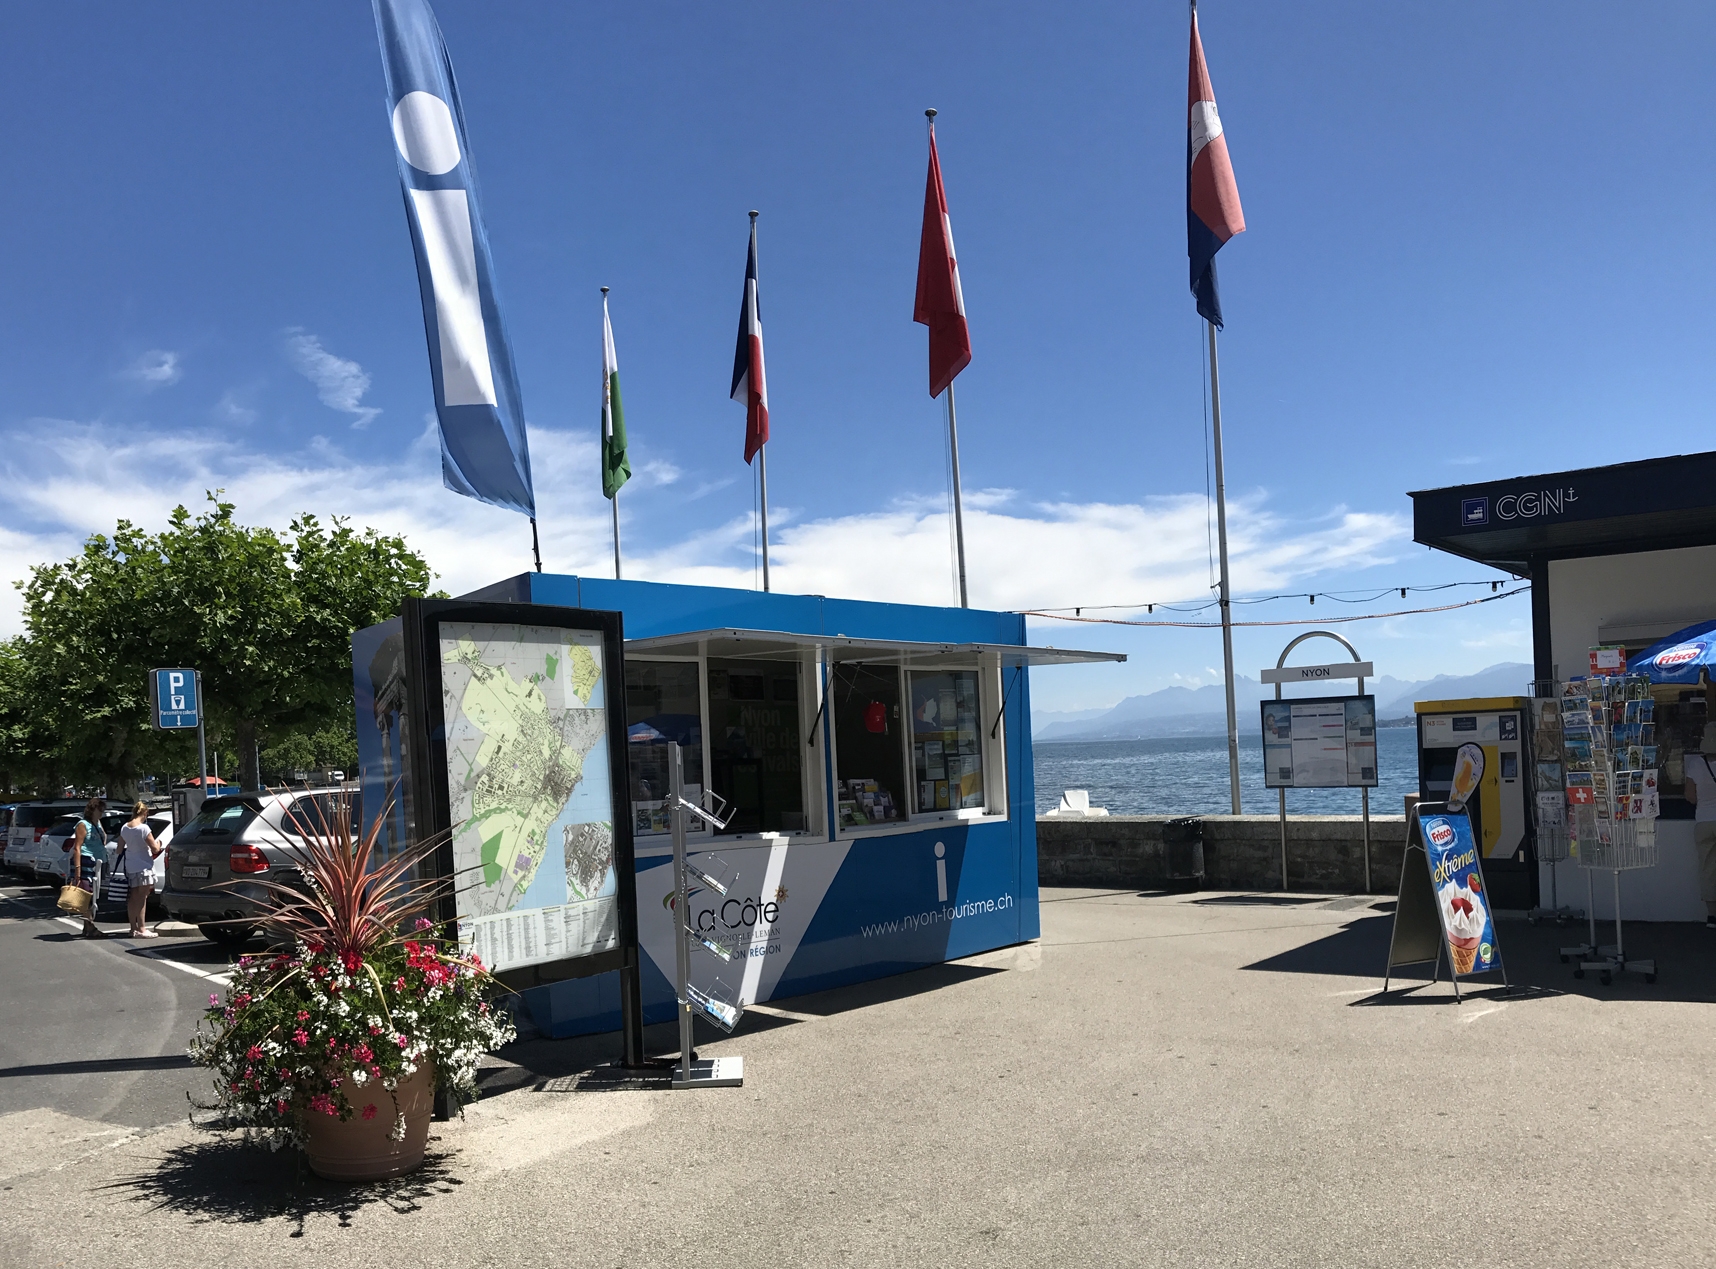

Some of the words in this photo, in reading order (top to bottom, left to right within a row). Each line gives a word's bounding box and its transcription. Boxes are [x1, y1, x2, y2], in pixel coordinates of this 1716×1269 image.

[1496, 488, 1564, 520] CGN
[1658, 651, 1698, 665] Frisco
[169, 672, 184, 695] P
[1301, 668, 1330, 677] NYON
[741, 704, 781, 730] Nyon
[780, 726, 799, 749] de
[1431, 828, 1452, 842] Frisco
[721, 896, 780, 928] Côte
[861, 892, 1013, 938] www.nyon-tourisme.ch
[749, 944, 781, 958] RÉGION
